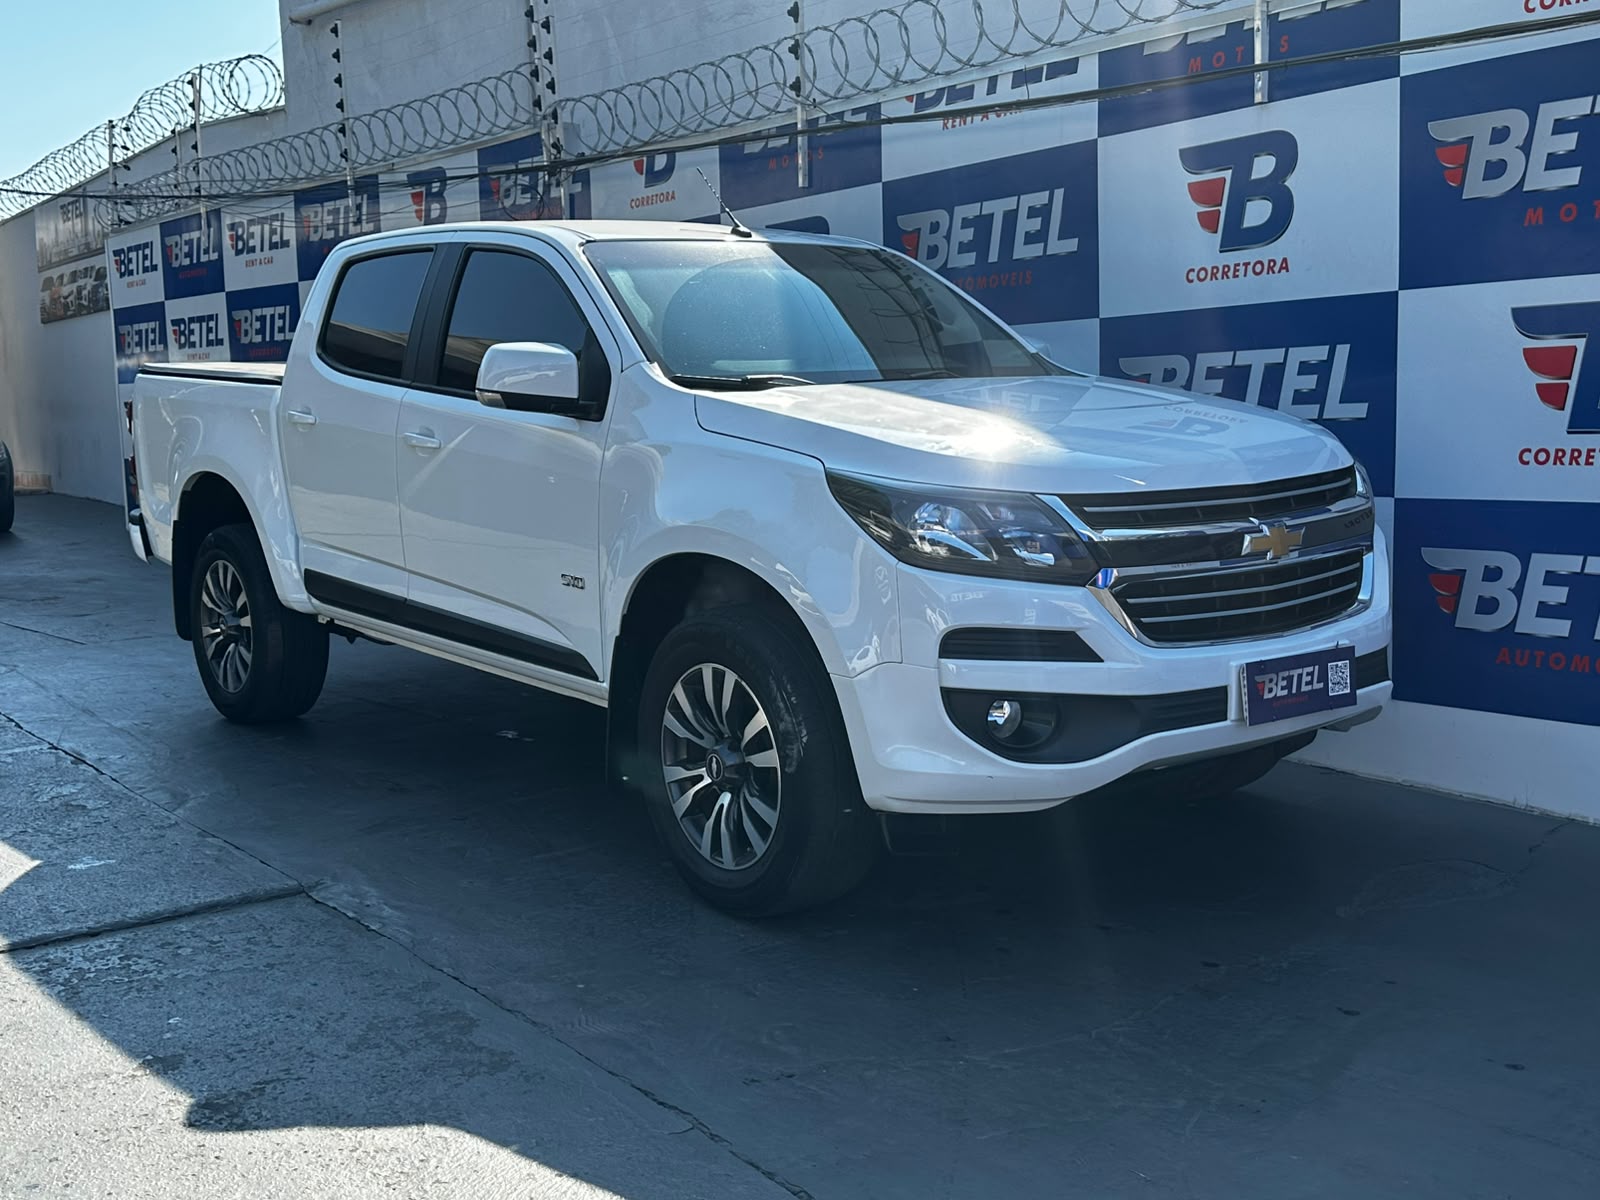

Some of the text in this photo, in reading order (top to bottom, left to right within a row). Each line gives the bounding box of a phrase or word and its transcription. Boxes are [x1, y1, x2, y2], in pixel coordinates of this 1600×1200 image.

[1188, 35, 1289, 73] MOTS
[1428, 94, 1600, 200] BE
[630, 190, 676, 209] CORRETORA
[1179, 129, 1299, 253] B
[227, 212, 290, 256] BETEL
[301, 194, 375, 241] BETEL
[897, 187, 1079, 272] BETEL
[113, 241, 158, 279] BETEL
[165, 227, 218, 268] BETEL
[1185, 257, 1290, 284] CORRETORA
[118, 321, 164, 355] BETEL
[171, 313, 224, 350] BETEL
[232, 305, 296, 344] BETEL
[1119, 344, 1368, 420] BETEL
[1518, 448, 1600, 466] CORRE
[1421, 547, 1600, 641] BE
[1496, 648, 1600, 674] AUTOM
[1255, 665, 1323, 699] BETEL
